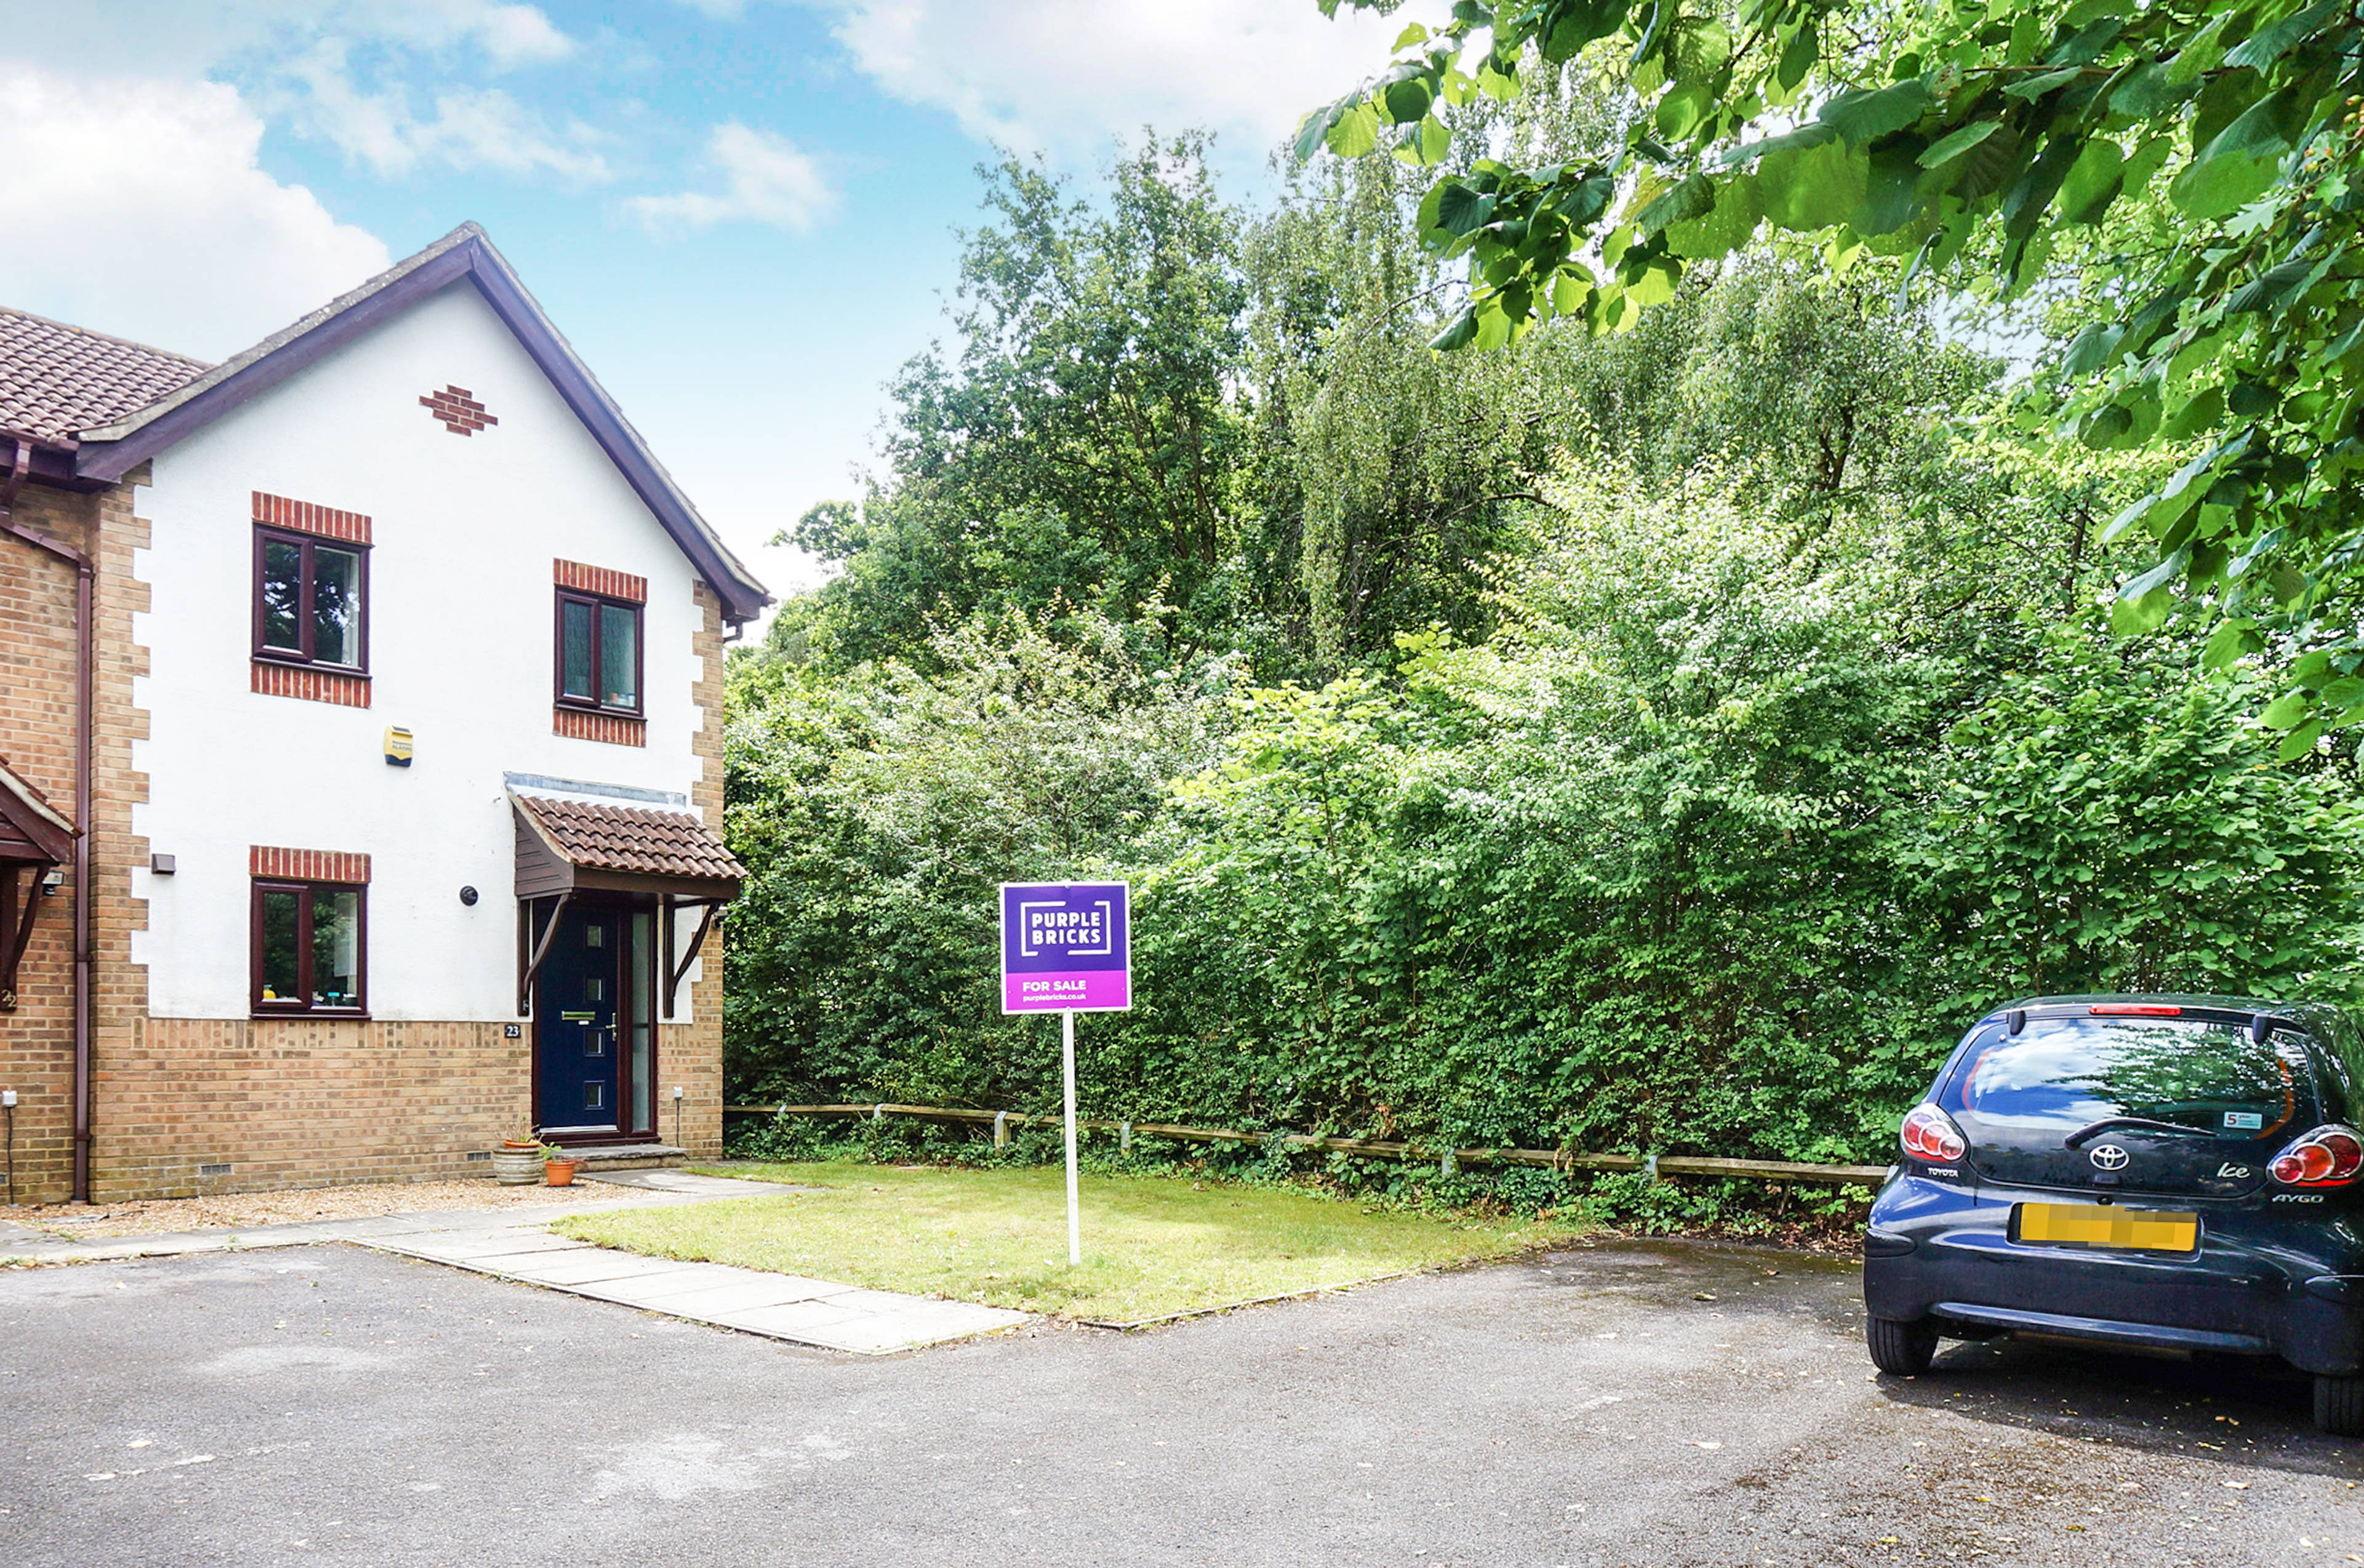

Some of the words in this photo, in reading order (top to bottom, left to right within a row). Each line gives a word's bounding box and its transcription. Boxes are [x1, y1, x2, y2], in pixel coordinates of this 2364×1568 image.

[1032, 912, 1100, 928] PURPLE
[1032, 929, 1101, 945] BRICKS
[1023, 981, 1050, 992] FOR
[1053, 980, 1087, 991] SALE
[1, 989, 17, 1007] 22
[1023, 993, 1086, 1002] purplebricks.co.uk
[507, 1026, 518, 1037] 23
[2227, 1114, 2237, 1125] 5
[1928, 1167, 1959, 1178] TOYOTA
[2217, 1162, 2251, 1178] Ice
[2272, 1194, 2324, 1203] AYGO
